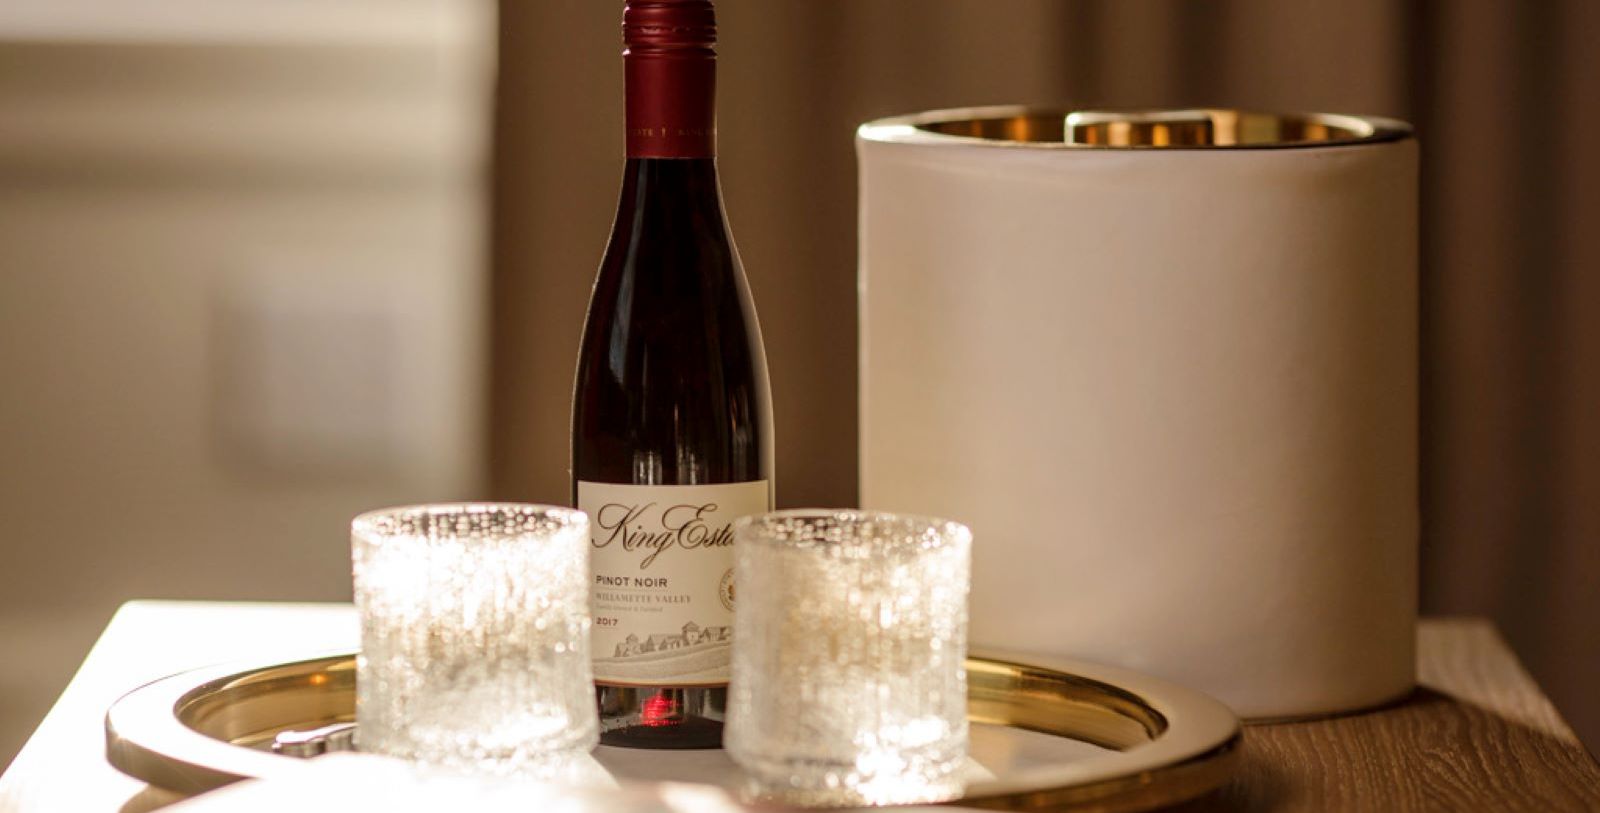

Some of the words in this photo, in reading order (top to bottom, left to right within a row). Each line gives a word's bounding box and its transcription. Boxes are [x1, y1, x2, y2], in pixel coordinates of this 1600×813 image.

[591, 502, 675, 570] King
[661, 503, 736, 550] Esta
[595, 575, 630, 587] PINOT
[634, 575, 668, 588] NOIR
[654, 593, 692, 604] VALLEY
[595, 616, 619, 627] 2017
